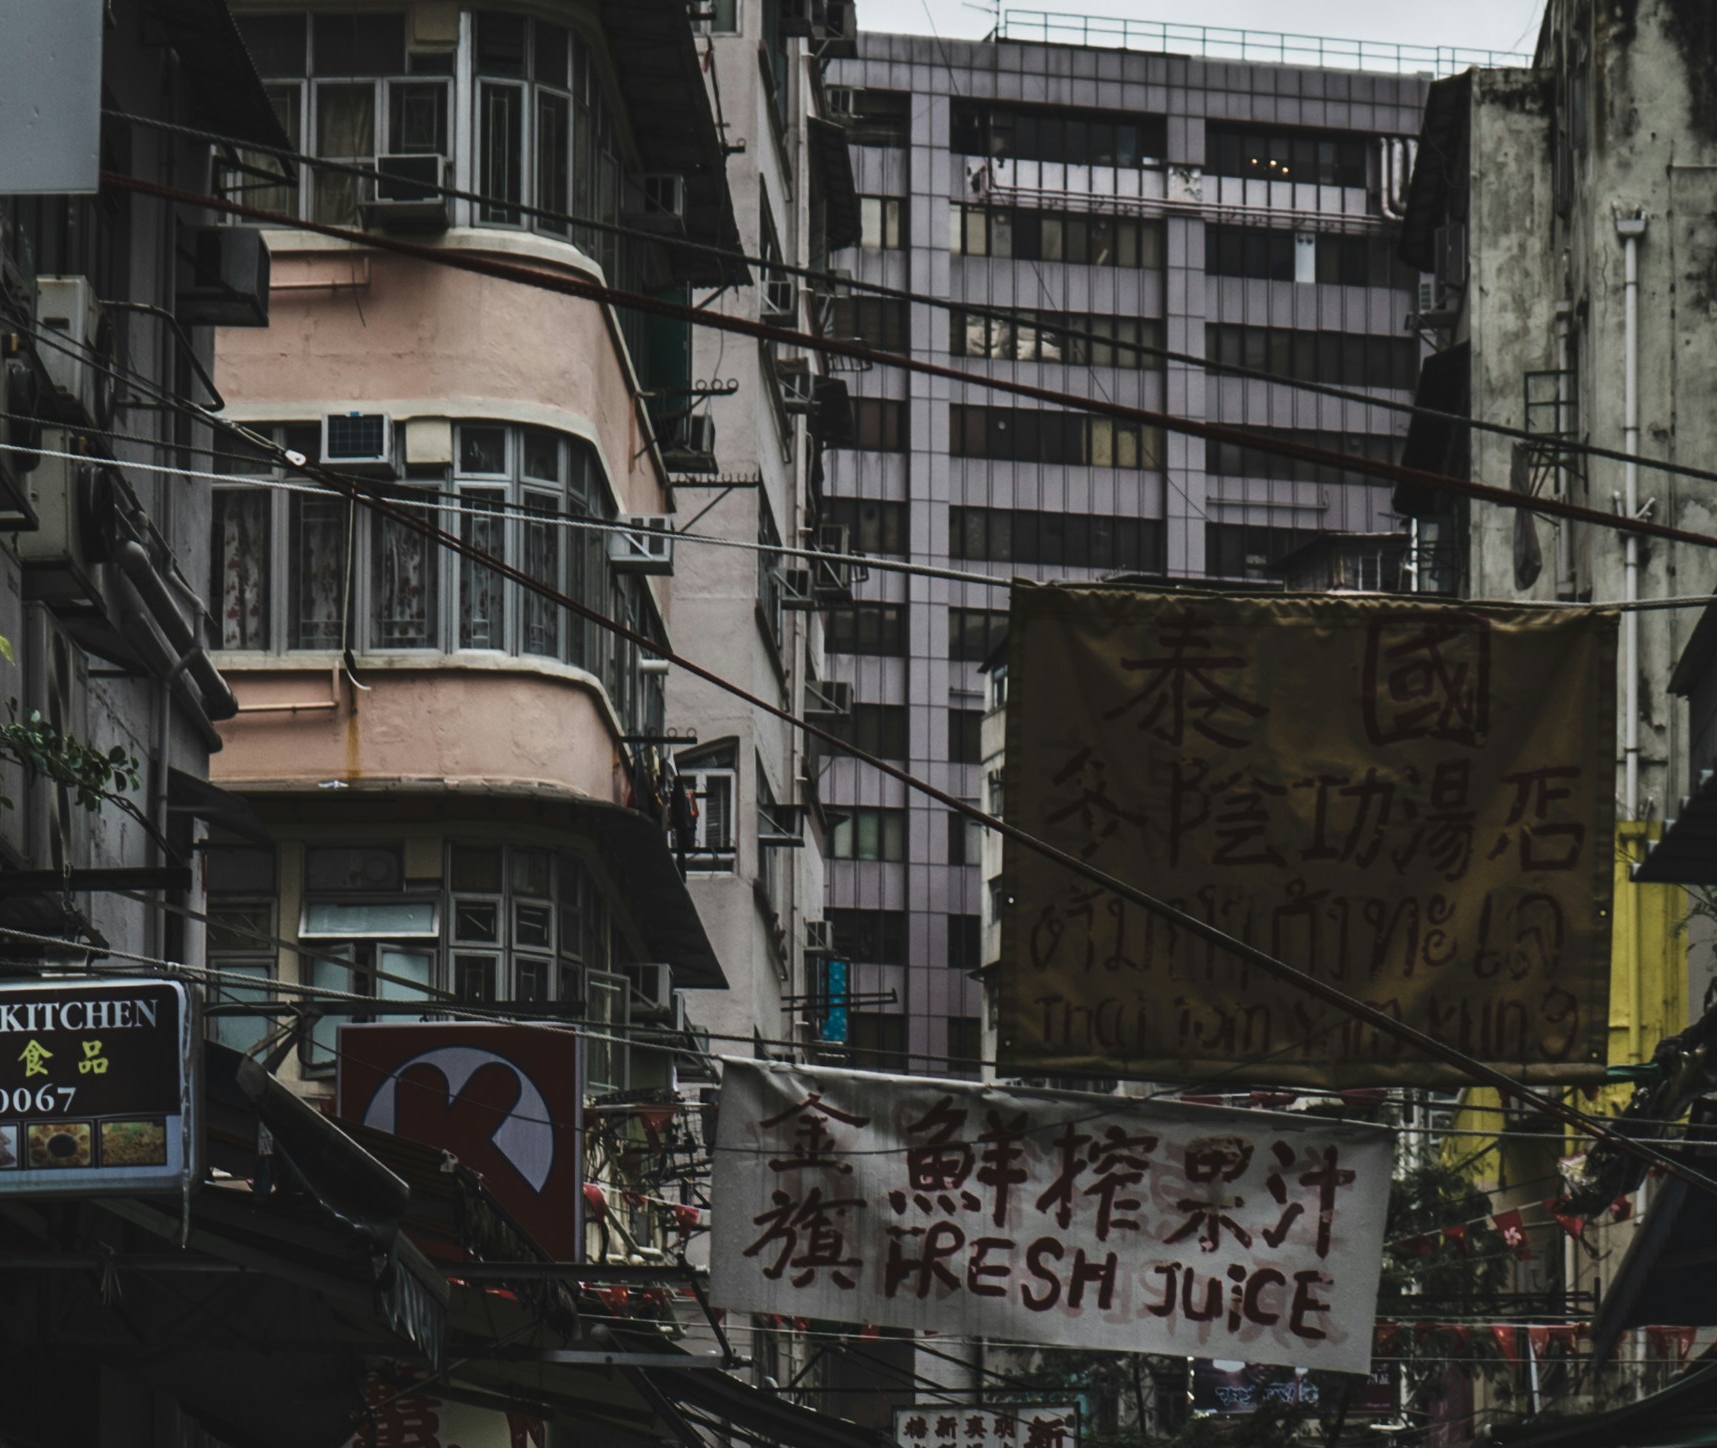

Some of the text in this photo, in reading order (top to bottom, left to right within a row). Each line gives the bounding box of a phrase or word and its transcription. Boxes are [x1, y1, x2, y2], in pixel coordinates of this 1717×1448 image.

[1102, 606, 1492, 750] 泰國
[742, 1092, 872, 1290] 金旗
[884, 1220, 1117, 1312] FRESH
